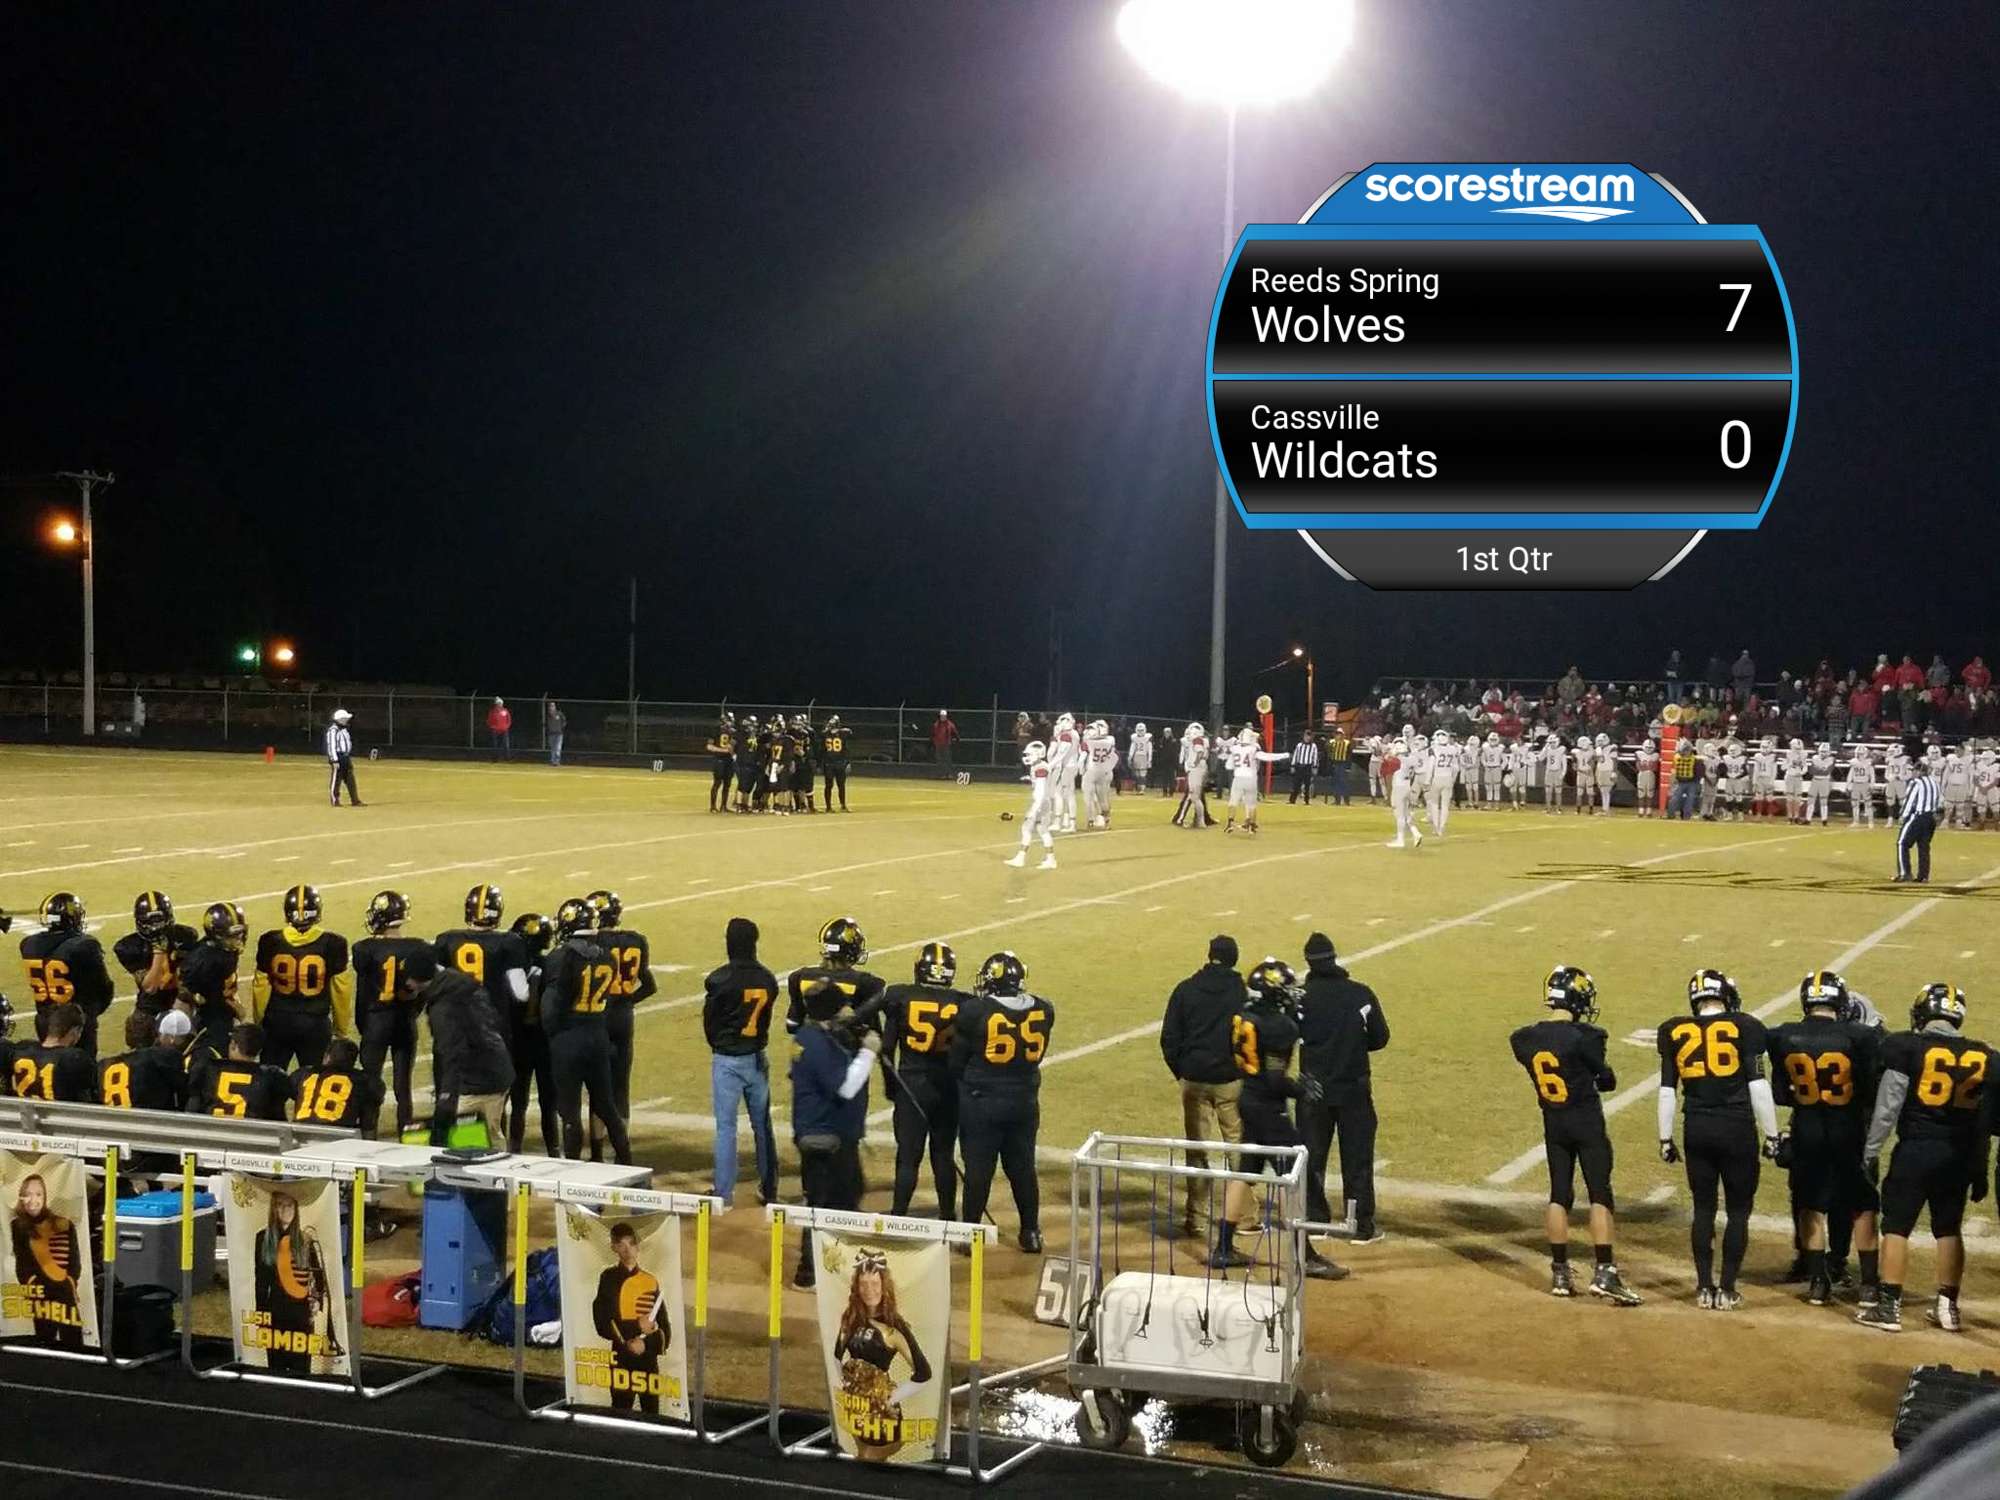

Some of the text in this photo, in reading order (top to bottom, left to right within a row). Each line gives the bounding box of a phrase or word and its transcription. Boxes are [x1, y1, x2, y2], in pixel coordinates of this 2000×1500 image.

[957, 772, 970, 785] 20
[1233, 753, 1251, 768] 24
[1437, 753, 1455, 768] 27
[24, 959, 75, 1004] 56
[271, 954, 326, 996] 90
[456, 942, 484, 984] 9
[575, 964, 613, 1012] 12
[741, 988, 768, 1037] 7
[985, 1010, 1045, 1063] 65
[1671, 1020, 1740, 1078] 26
[14, 1058, 55, 1100] 21
[103, 1062, 132, 1108] 8
[212, 1071, 252, 1119] 5
[295, 1073, 353, 1120] 18
[1532, 1051, 1568, 1102] 6
[1785, 1052, 1853, 1105] 83
[1918, 1047, 1987, 1108] 62
[231, 1157, 270, 1169] CASSVILLE
[284, 1162, 321, 1173] WILDCATS
[566, 1187, 609, 1200] CASSVILLE
[622, 1193, 662, 1205] WILDCATS
[824, 1214, 870, 1227] CASSVILLE
[886, 1221, 930, 1234] WILDCATS
